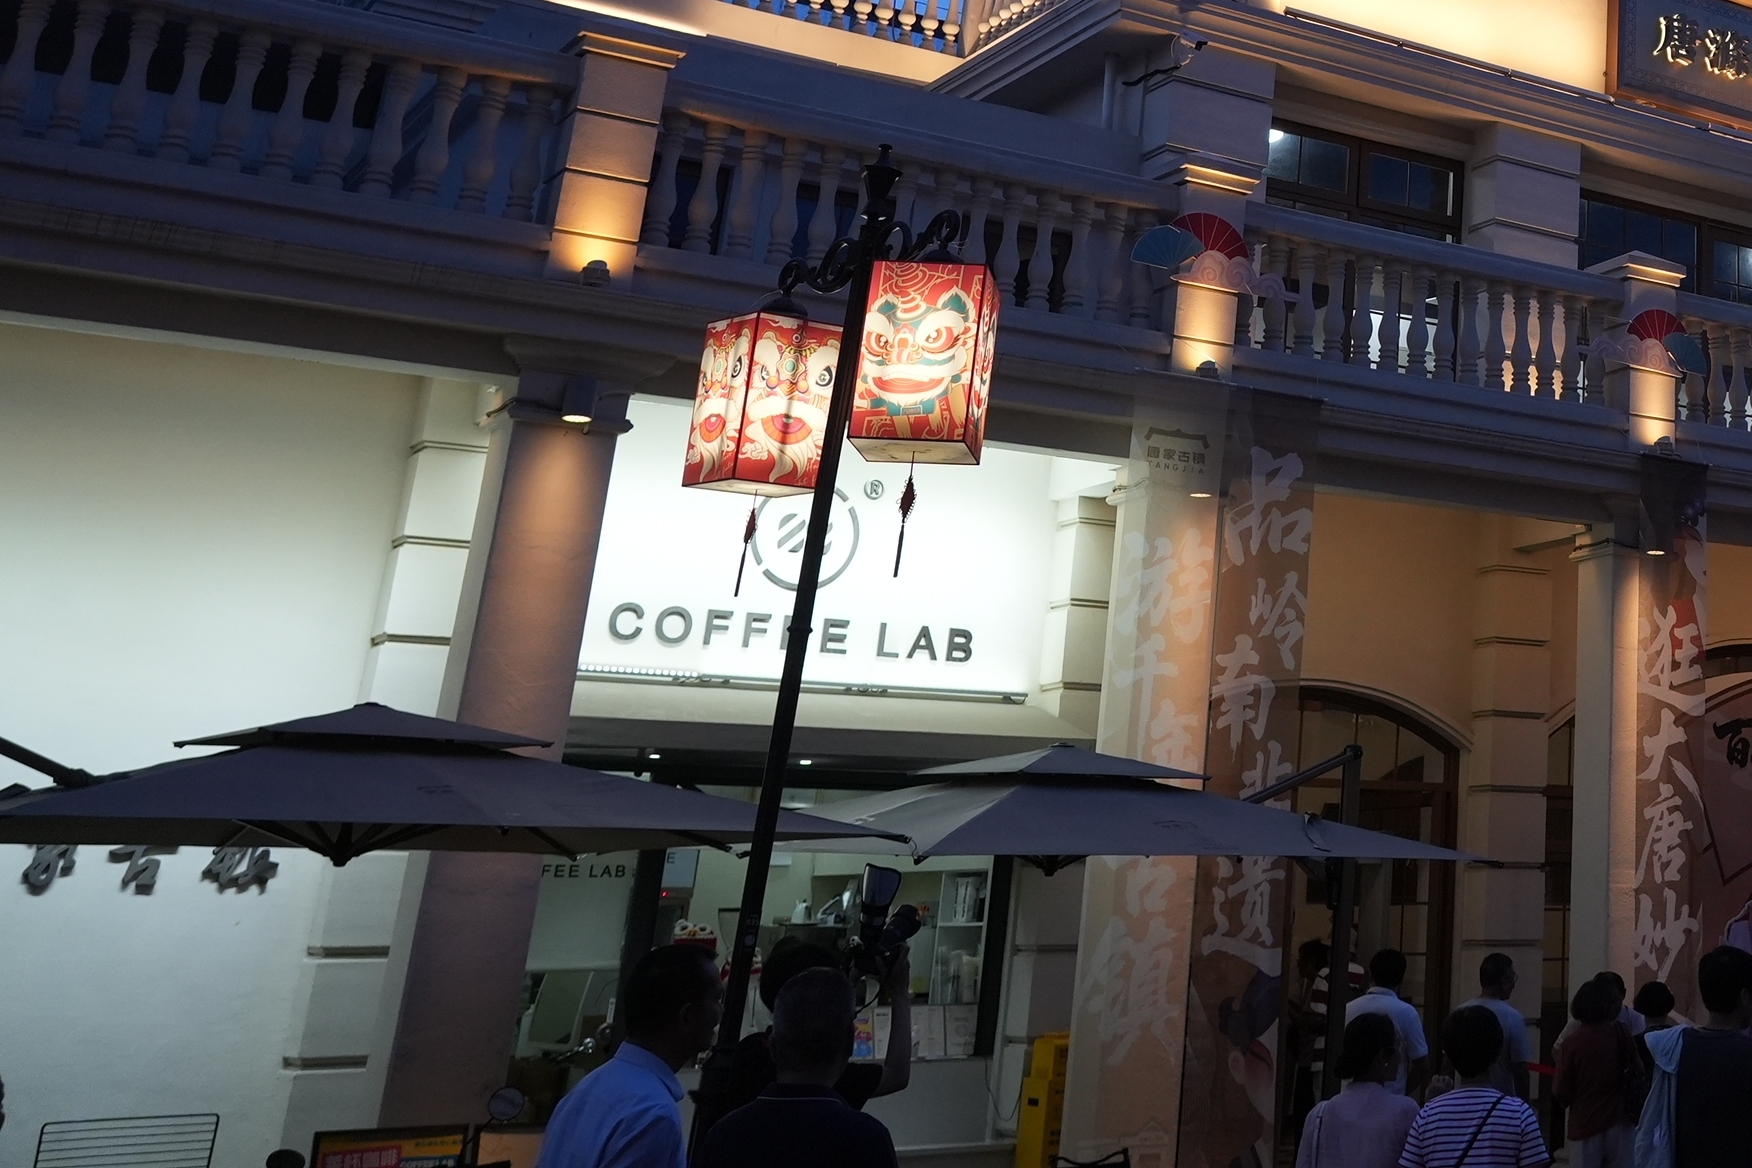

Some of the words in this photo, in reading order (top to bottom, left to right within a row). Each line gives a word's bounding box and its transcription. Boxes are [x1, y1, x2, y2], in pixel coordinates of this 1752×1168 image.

[1146, 460, 1205, 475] TANGJIA
[876, 622, 973, 663] LAB
[588, 864, 626, 878] LAB
